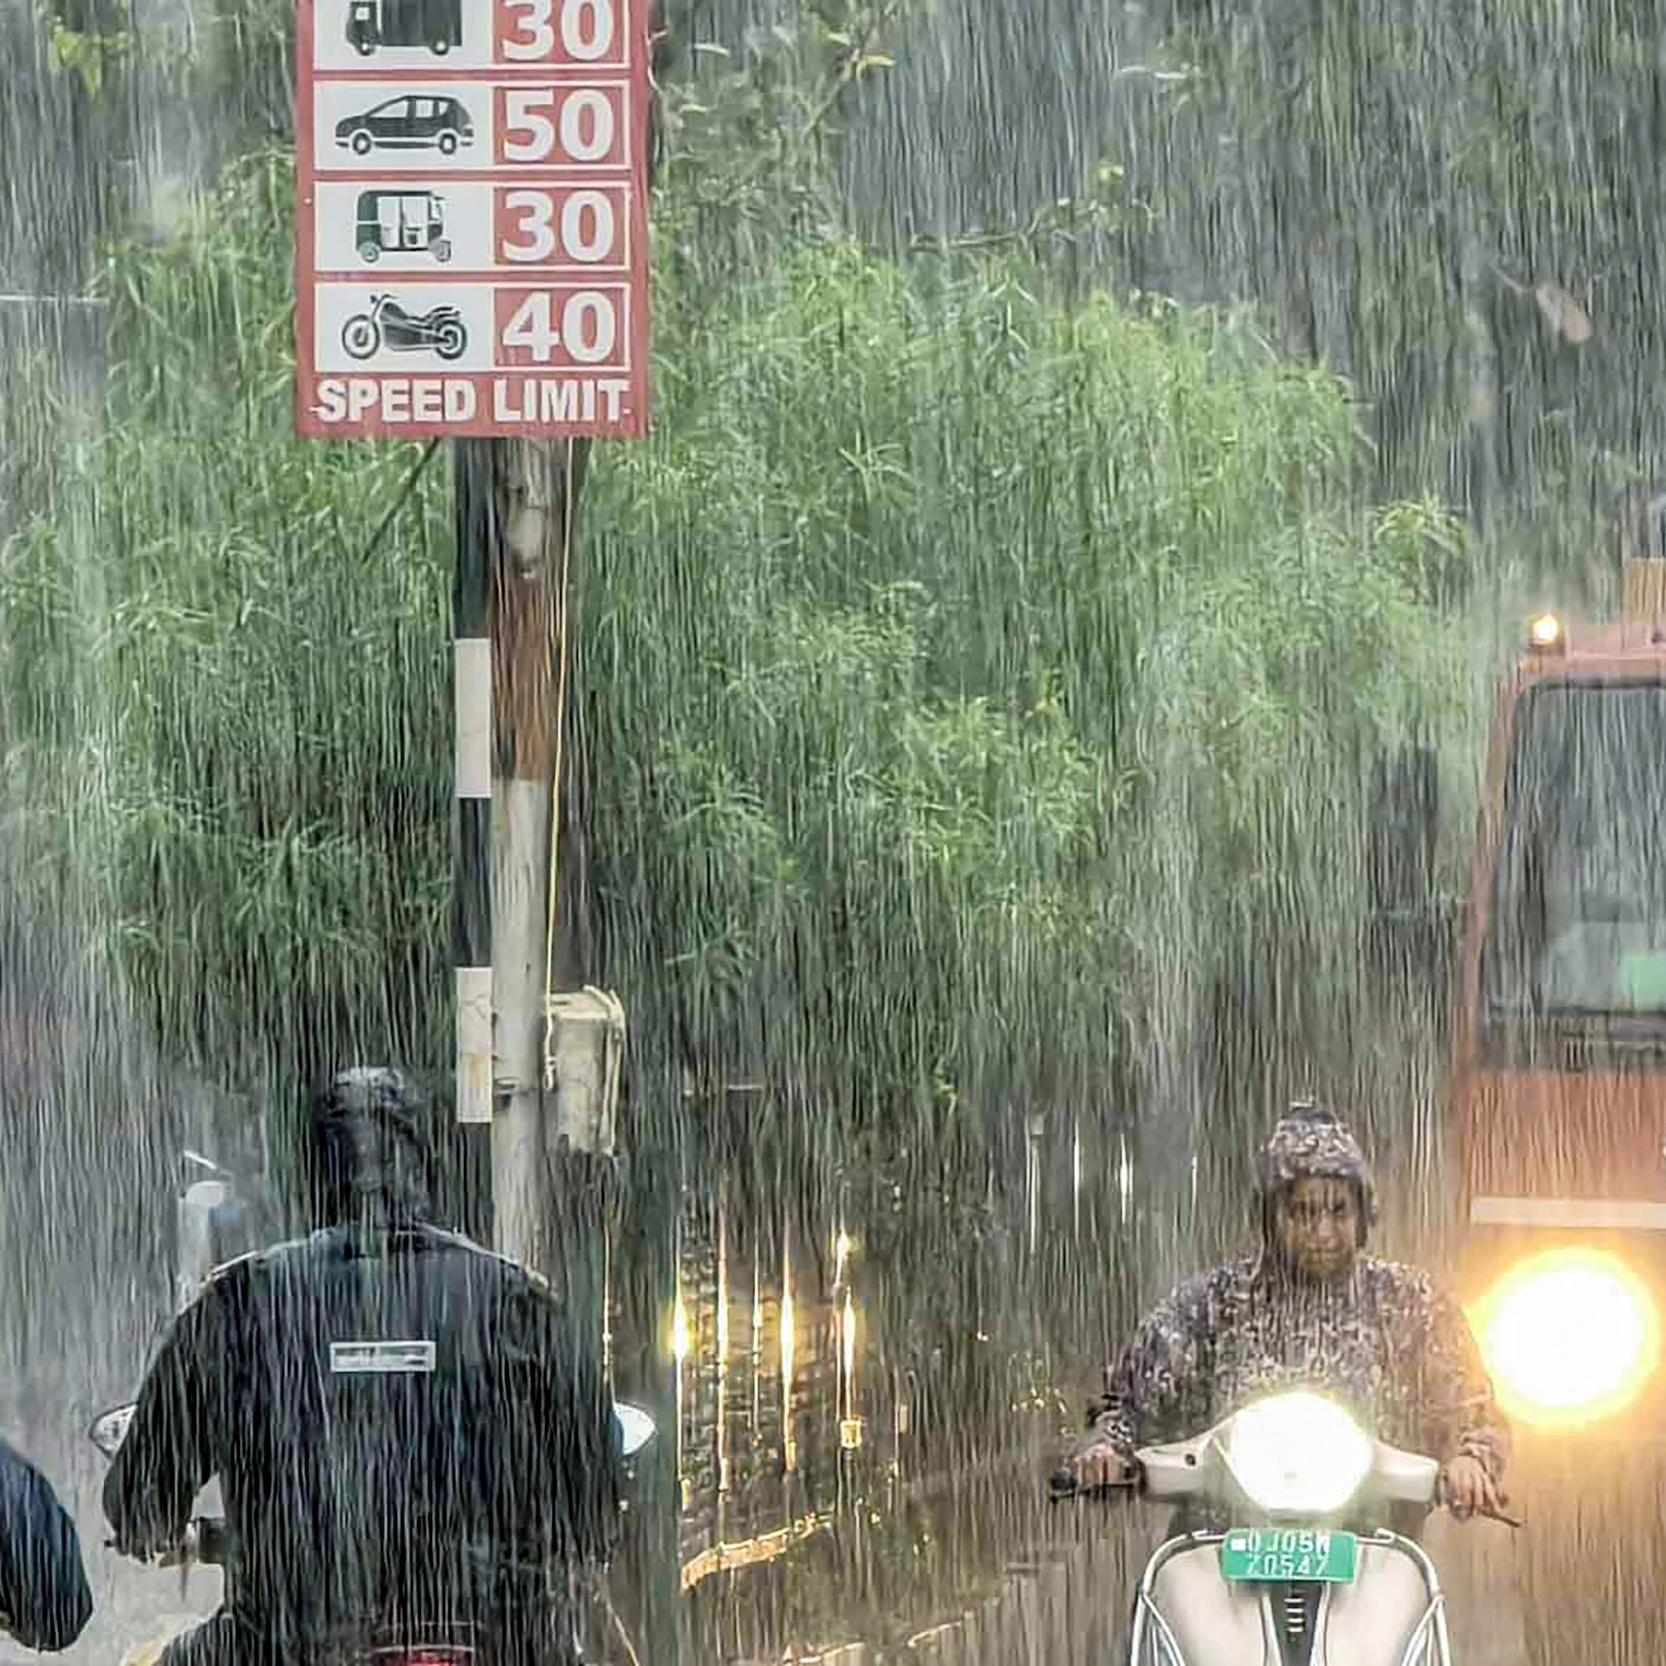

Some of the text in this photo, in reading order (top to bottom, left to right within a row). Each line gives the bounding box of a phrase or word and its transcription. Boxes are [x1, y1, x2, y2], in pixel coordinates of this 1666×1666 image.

[502, 0, 614, 61] 30
[502, 89, 614, 162] 50
[502, 190, 614, 262] 30
[501, 291, 616, 362] 40
[316, 377, 629, 424] SPEED LIMIT
